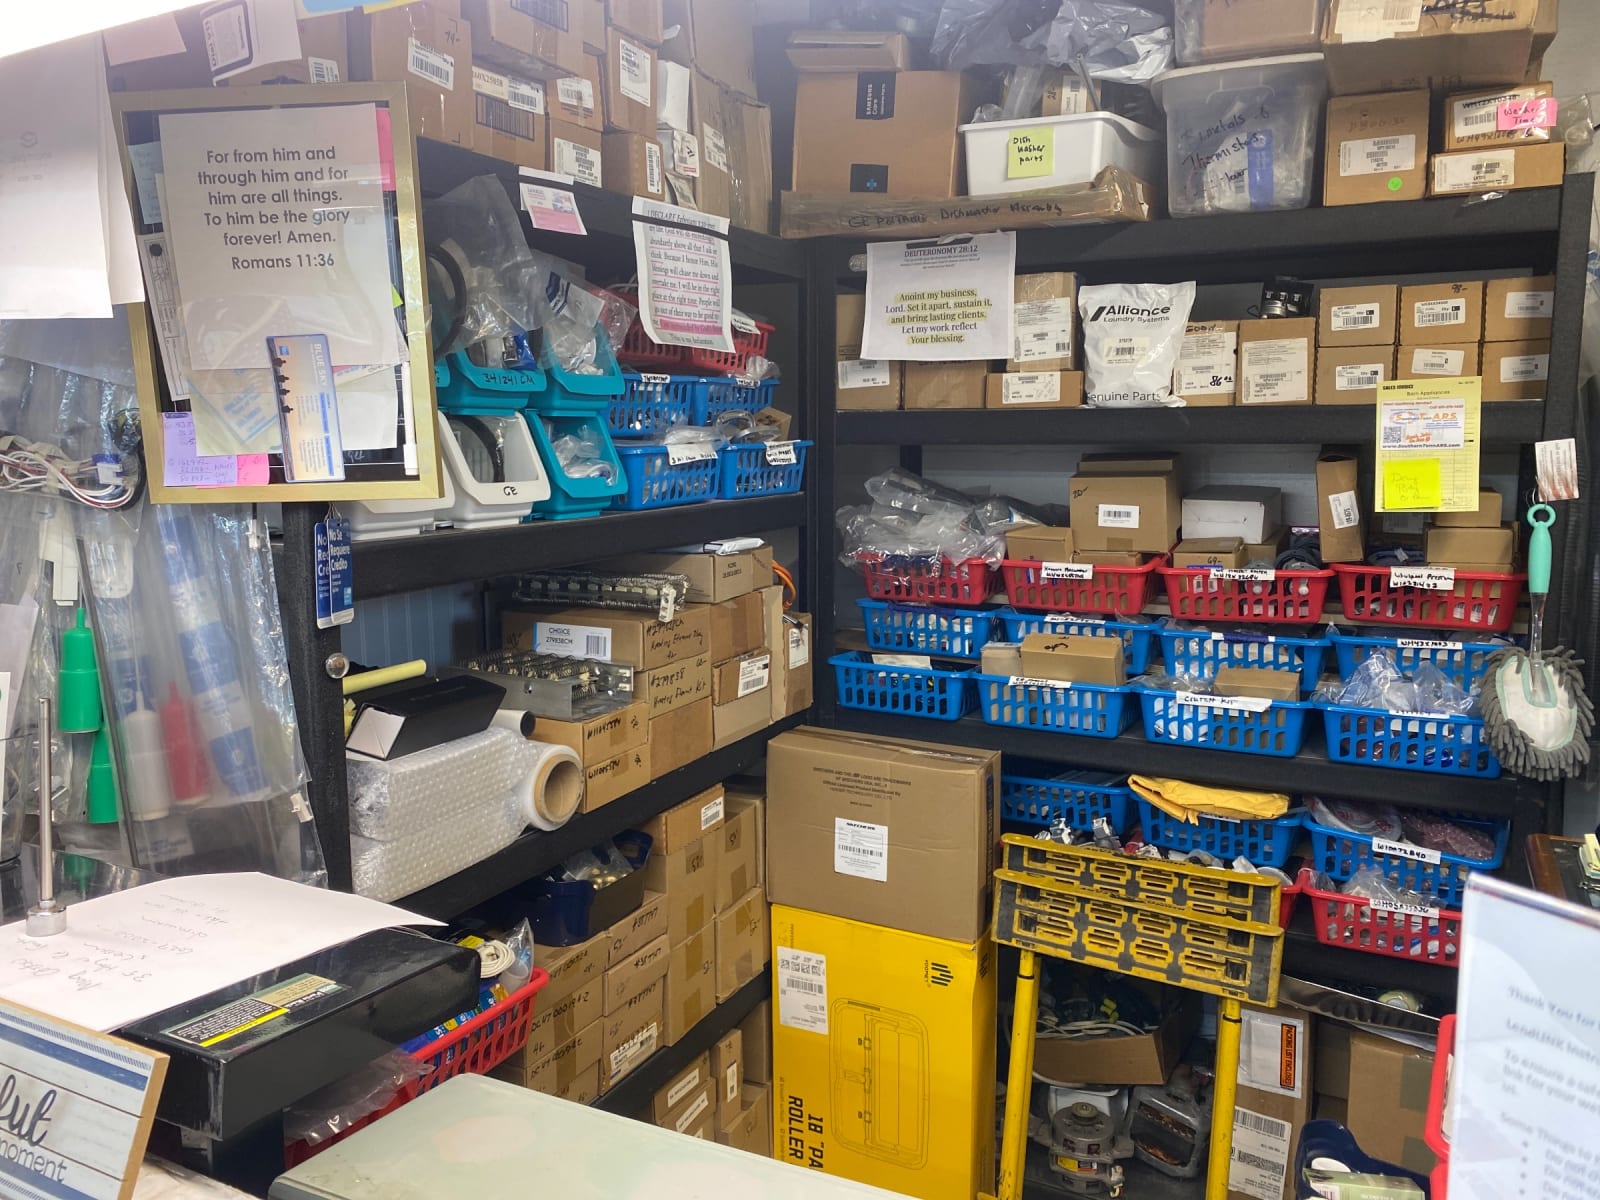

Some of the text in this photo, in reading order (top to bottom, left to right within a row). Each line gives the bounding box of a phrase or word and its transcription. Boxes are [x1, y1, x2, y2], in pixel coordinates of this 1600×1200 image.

[207, 146, 336, 164] For from him and
[1020, 155, 1043, 165] parts
[198, 166, 348, 186] through him and for
[208, 188, 343, 205] him are all things.
[204, 209, 350, 226] To him be the glory
[224, 230, 336, 246] forever! Amen.
[904, 245, 978, 257] DEUTERONOMY 28:12
[232, 254, 334, 270] Romans 11:36
[670, 266, 678, 274] will
[679, 268, 691, 276] chase
[899, 292, 925, 301] Anoint
[927, 292, 939, 300] my
[907, 303, 920, 312] Set
[922, 302, 928, 311] it
[953, 300, 982, 308] sustain
[1105, 304, 1170, 317] Alliance
[891, 314, 906, 324] and
[907, 314, 928, 323] bring
[929, 312, 956, 321] lasting
[902, 322, 977, 334] Let my work reflect
[910, 334, 965, 344] Your blessing.
[314, 343, 324, 366] BLUE
[318, 369, 327, 386] SKY
[1133, 392, 1160, 400] Parts
[504, 486, 517, 496] GE
[328, 528, 336, 541] No
[330, 544, 350, 558] Requiere
[331, 557, 348, 571] Crédito
[1508, 985, 1595, 1028] Thank You for
[1504, 1047, 1519, 1064] To
[788, 1095, 804, 1159] ROLLER
[808, 1114, 824, 1134] 18
